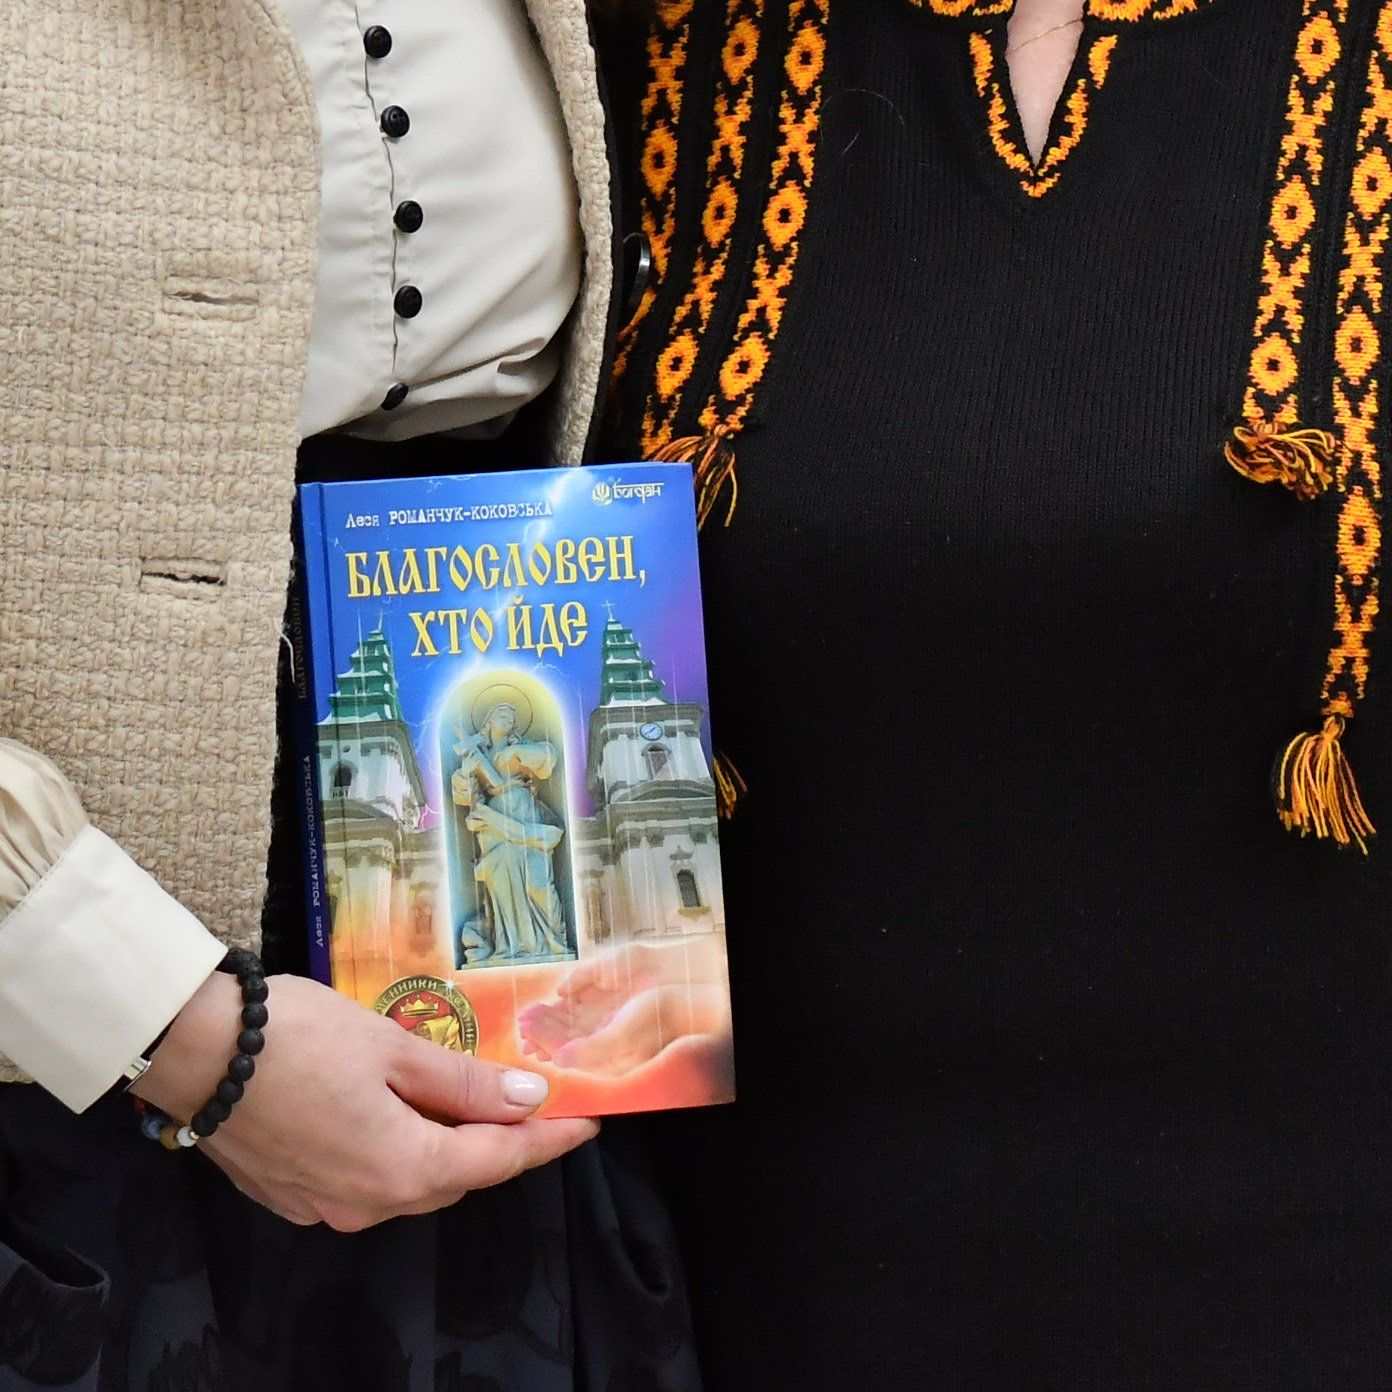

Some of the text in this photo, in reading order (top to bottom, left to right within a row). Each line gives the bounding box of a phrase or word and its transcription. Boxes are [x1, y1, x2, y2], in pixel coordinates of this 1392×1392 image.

[345, 501, 553, 528] Леся РОМАНЧУК-КОКОВСЬКА
[345, 535, 646, 598] БЛАГОСЛОВЕН,
[409, 594, 588, 658] ХТО ЙДЕ
